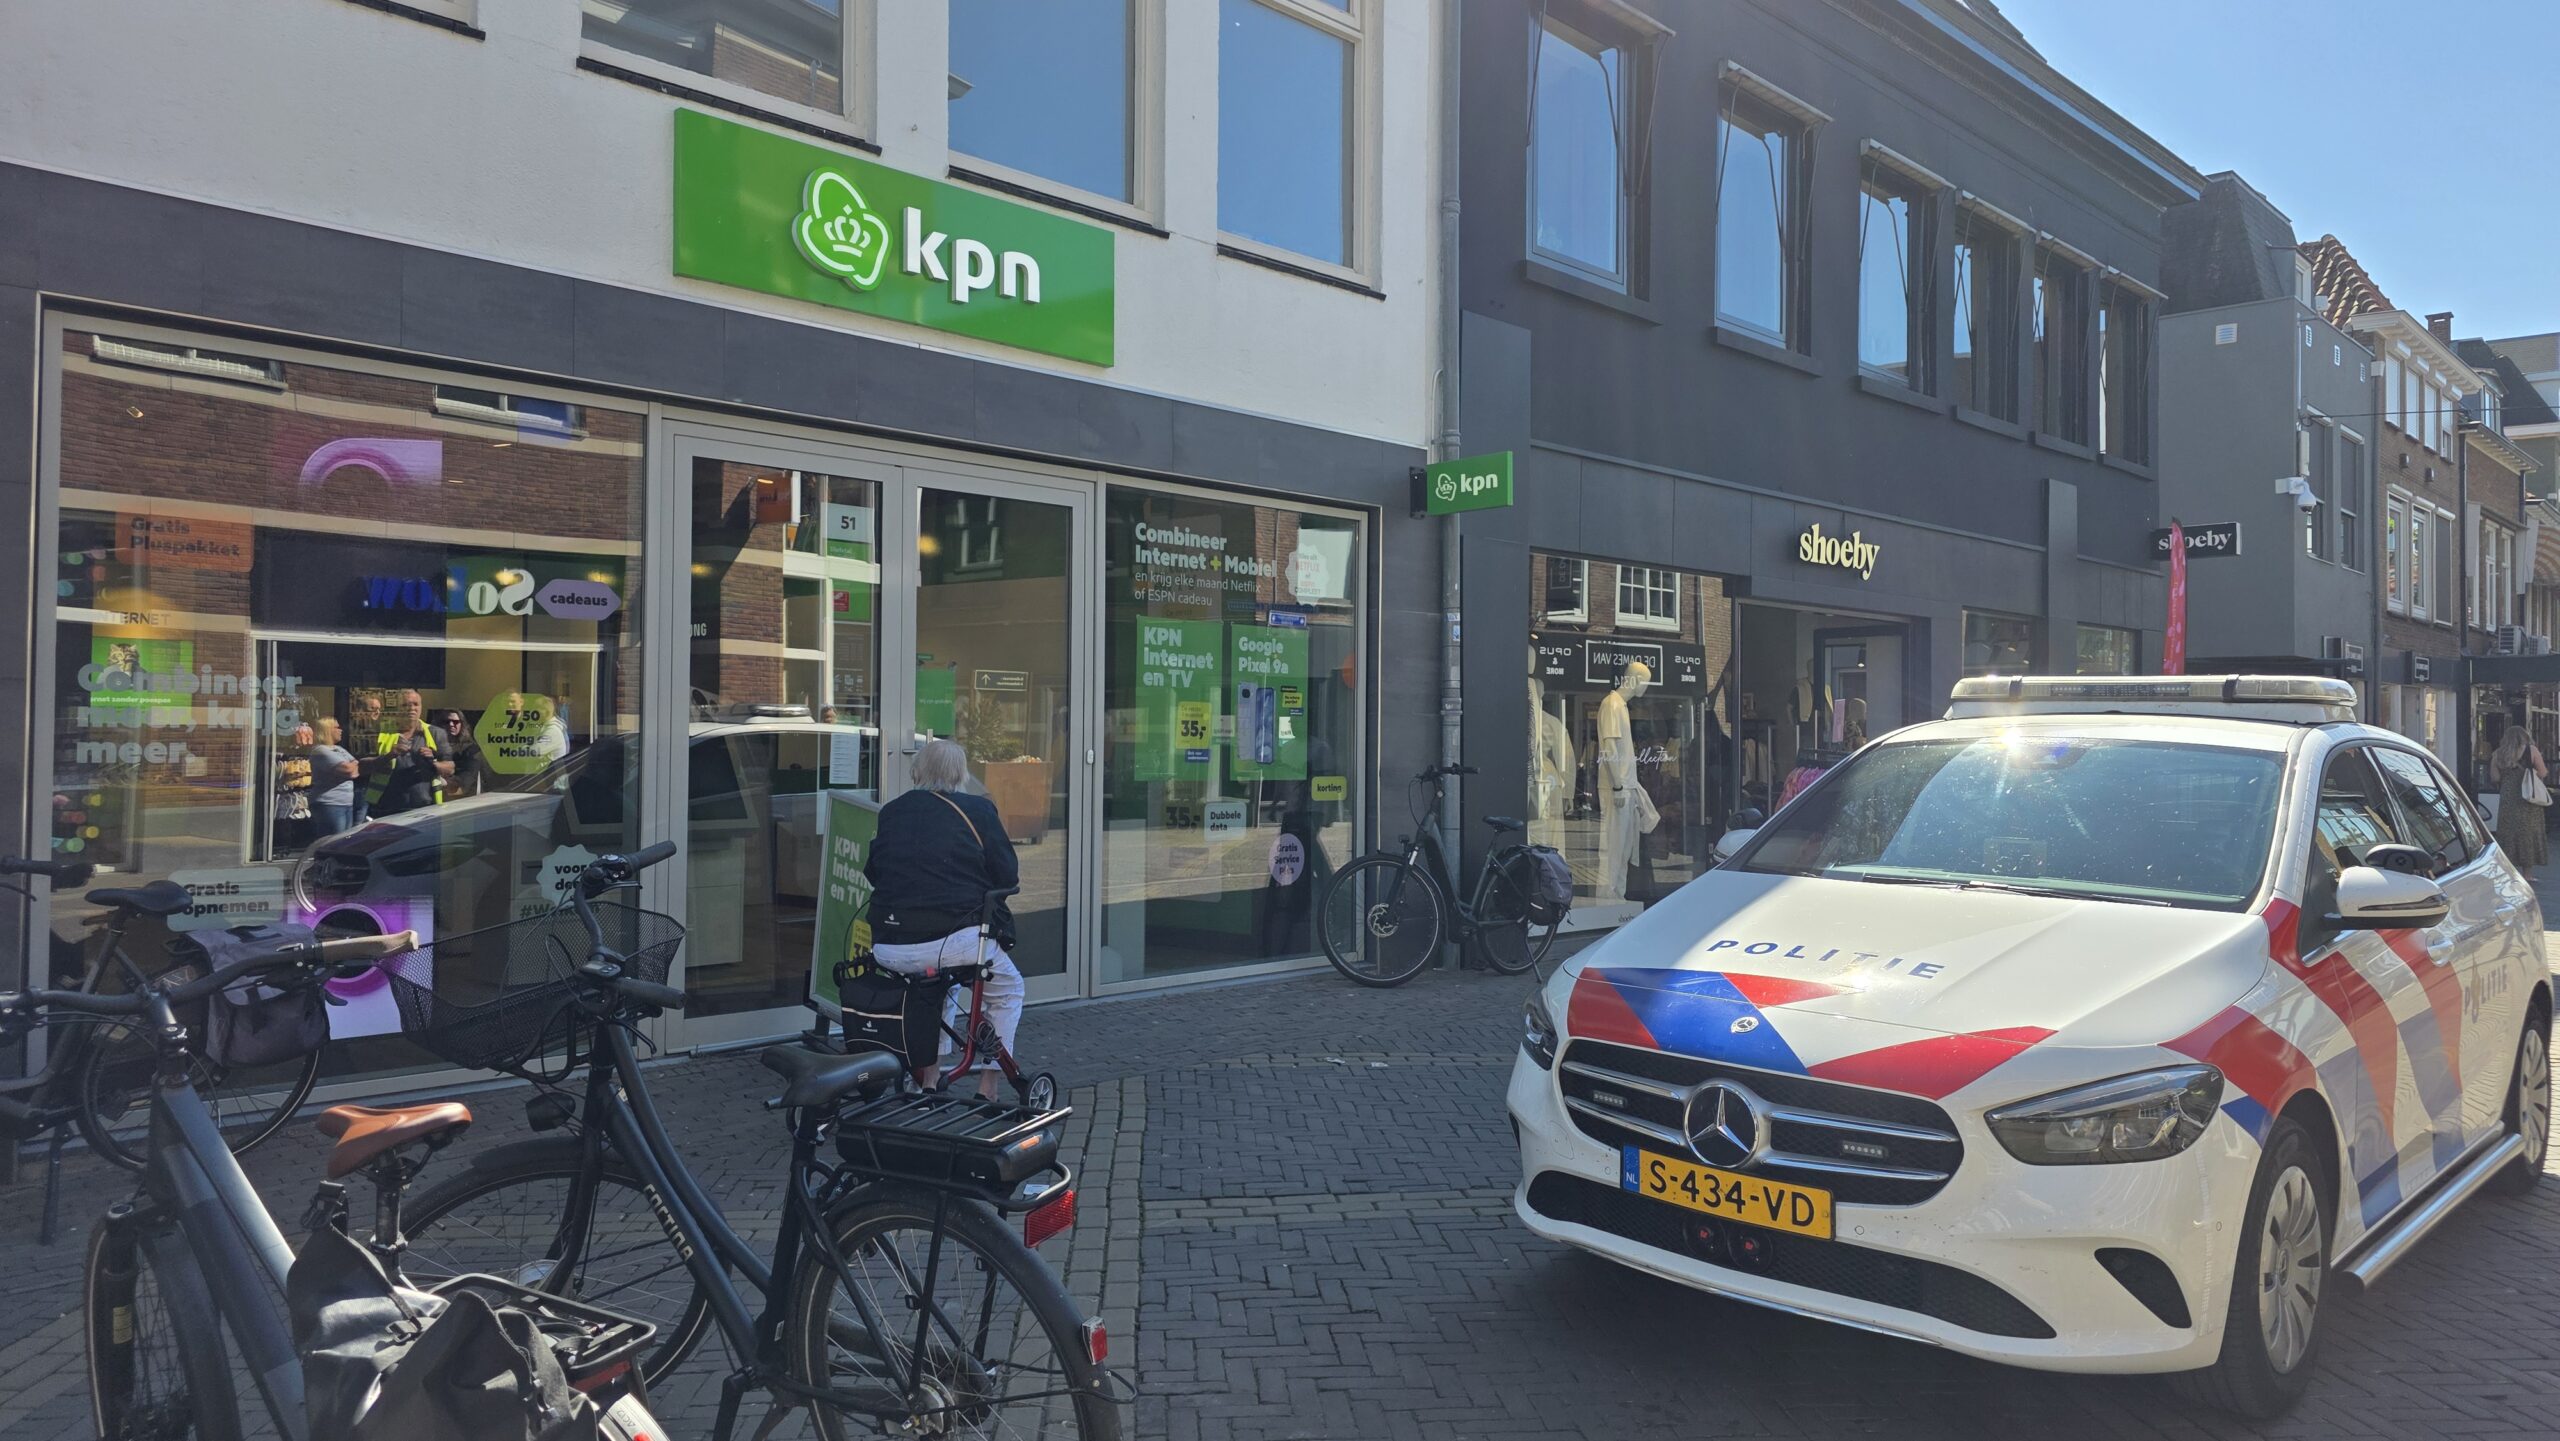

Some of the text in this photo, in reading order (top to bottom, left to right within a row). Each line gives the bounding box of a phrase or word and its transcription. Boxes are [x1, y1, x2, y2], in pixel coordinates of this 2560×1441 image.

[903, 206, 1040, 303] kpn
[1461, 473, 1498, 496] kpn
[131, 516, 190, 535] Gratis
[840, 516, 856, 531] 51
[131, 535, 240, 557] Pluspakket
[1135, 522, 1227, 550] Combineer
[2158, 530, 2232, 550] soeby
[1135, 545, 1206, 570] Internet
[1225, 555, 1277, 577] Mobiel
[1800, 523, 1880, 580] shoeby
[1135, 572, 1261, 593] en krijg elke maand Netflix
[550, 587, 608, 606] cadeaus
[1134, 588, 1212, 606] of ESPN cadeau
[1144, 626, 1182, 647] KPN
[1239, 636, 1284, 656] Google
[1143, 647, 1213, 669] Internet
[1239, 657, 1289, 674] Pixel 9a
[78, 663, 302, 696] Combineer
[1143, 670, 1193, 688] en TV
[76, 699, 301, 736] meer, krijg
[488, 733, 534, 746] korting
[1181, 720, 1206, 739] 35,-
[76, 741, 196, 764] meer.
[1317, 783, 1342, 794] korting
[1210, 810, 1241, 820] Dubbele
[1210, 822, 1228, 832] data
[834, 835, 860, 863] KPN
[555, 865, 587, 874] voor
[183, 881, 240, 896] Gratis
[830, 883, 865, 909] en TV
[182, 901, 270, 917] opnemen
[1706, 940, 1945, 979] POLITIE
[1626, 1172, 1638, 1184] NL
[1650, 1159, 1814, 1227] S-434-VD
